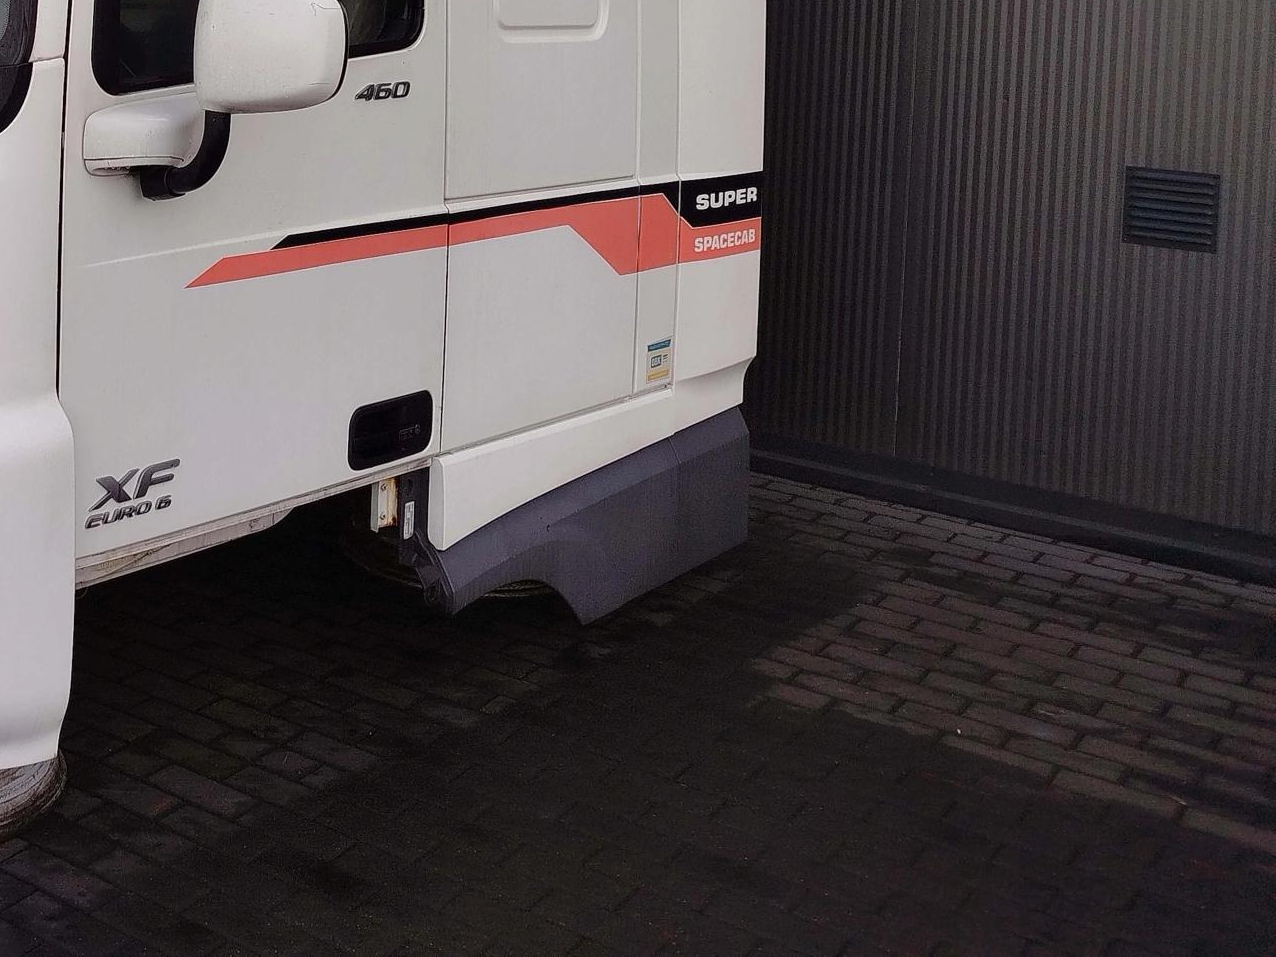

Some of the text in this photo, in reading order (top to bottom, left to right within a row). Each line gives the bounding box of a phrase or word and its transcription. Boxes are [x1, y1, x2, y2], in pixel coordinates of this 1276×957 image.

[355, 81, 410, 101] 460
[695, 186, 758, 210] SUPER
[694, 228, 756, 253] SPACECAB
[88, 458, 181, 512] XF
[85, 494, 172, 530] EURO 6
